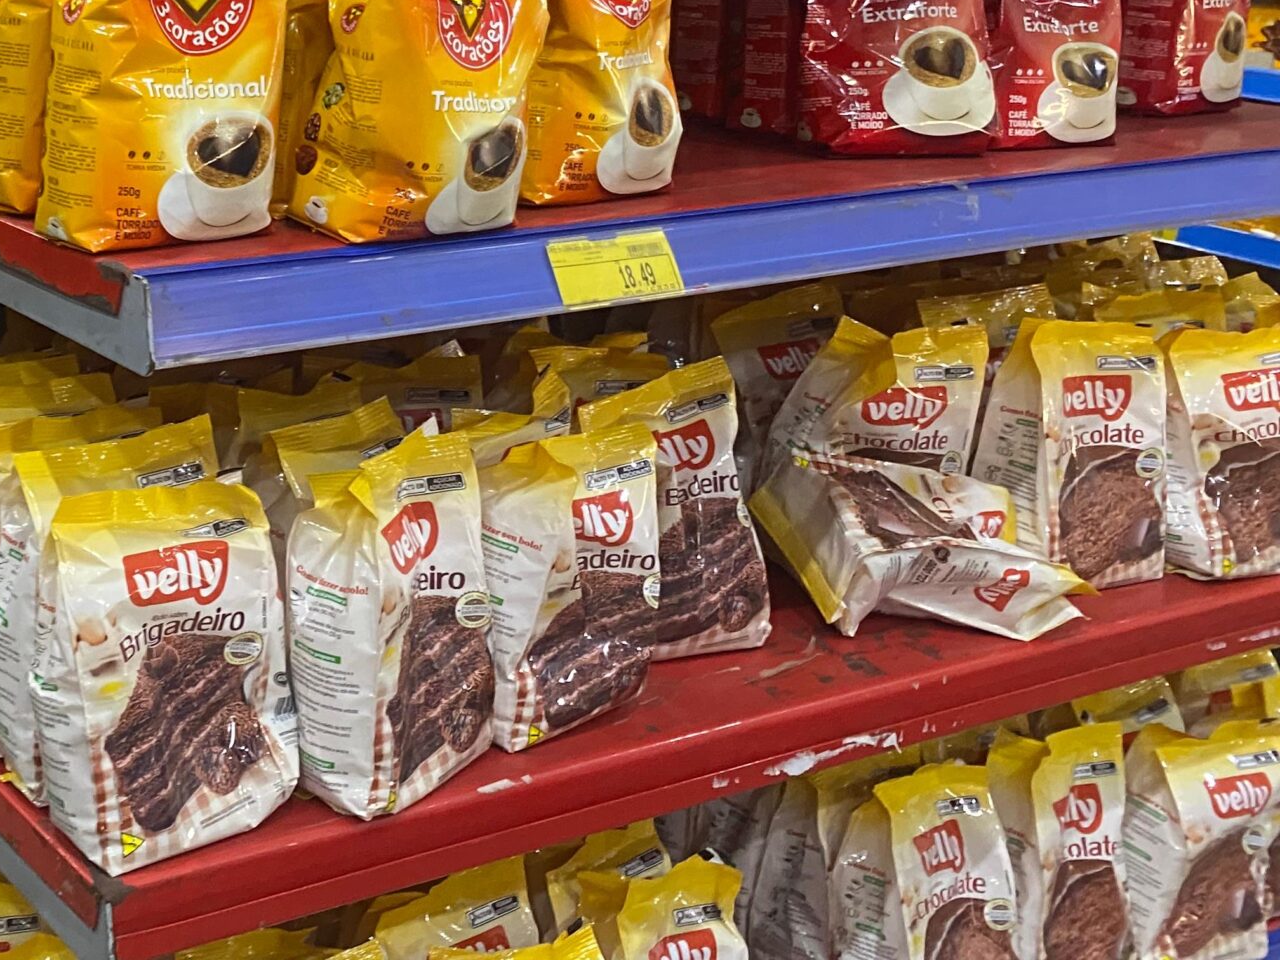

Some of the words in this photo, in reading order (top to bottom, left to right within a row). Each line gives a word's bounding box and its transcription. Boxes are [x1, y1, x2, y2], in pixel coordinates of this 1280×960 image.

[157, 1, 171, 18] 3
[165, 1, 245, 47] corações
[442, 14, 456, 30] 3
[444, 19, 502, 63] corações
[141, 74, 268, 100] Tradicional
[118, 187, 140, 199] 250g
[620, 262, 656, 289] 18.49
[868, 392, 941, 425] velly
[391, 513, 432, 568] velly
[518, 535, 543, 552] bolo!
[132, 549, 224, 601] velly
[119, 607, 246, 663] Brigadeiro
[1214, 779, 1269, 814] velly
